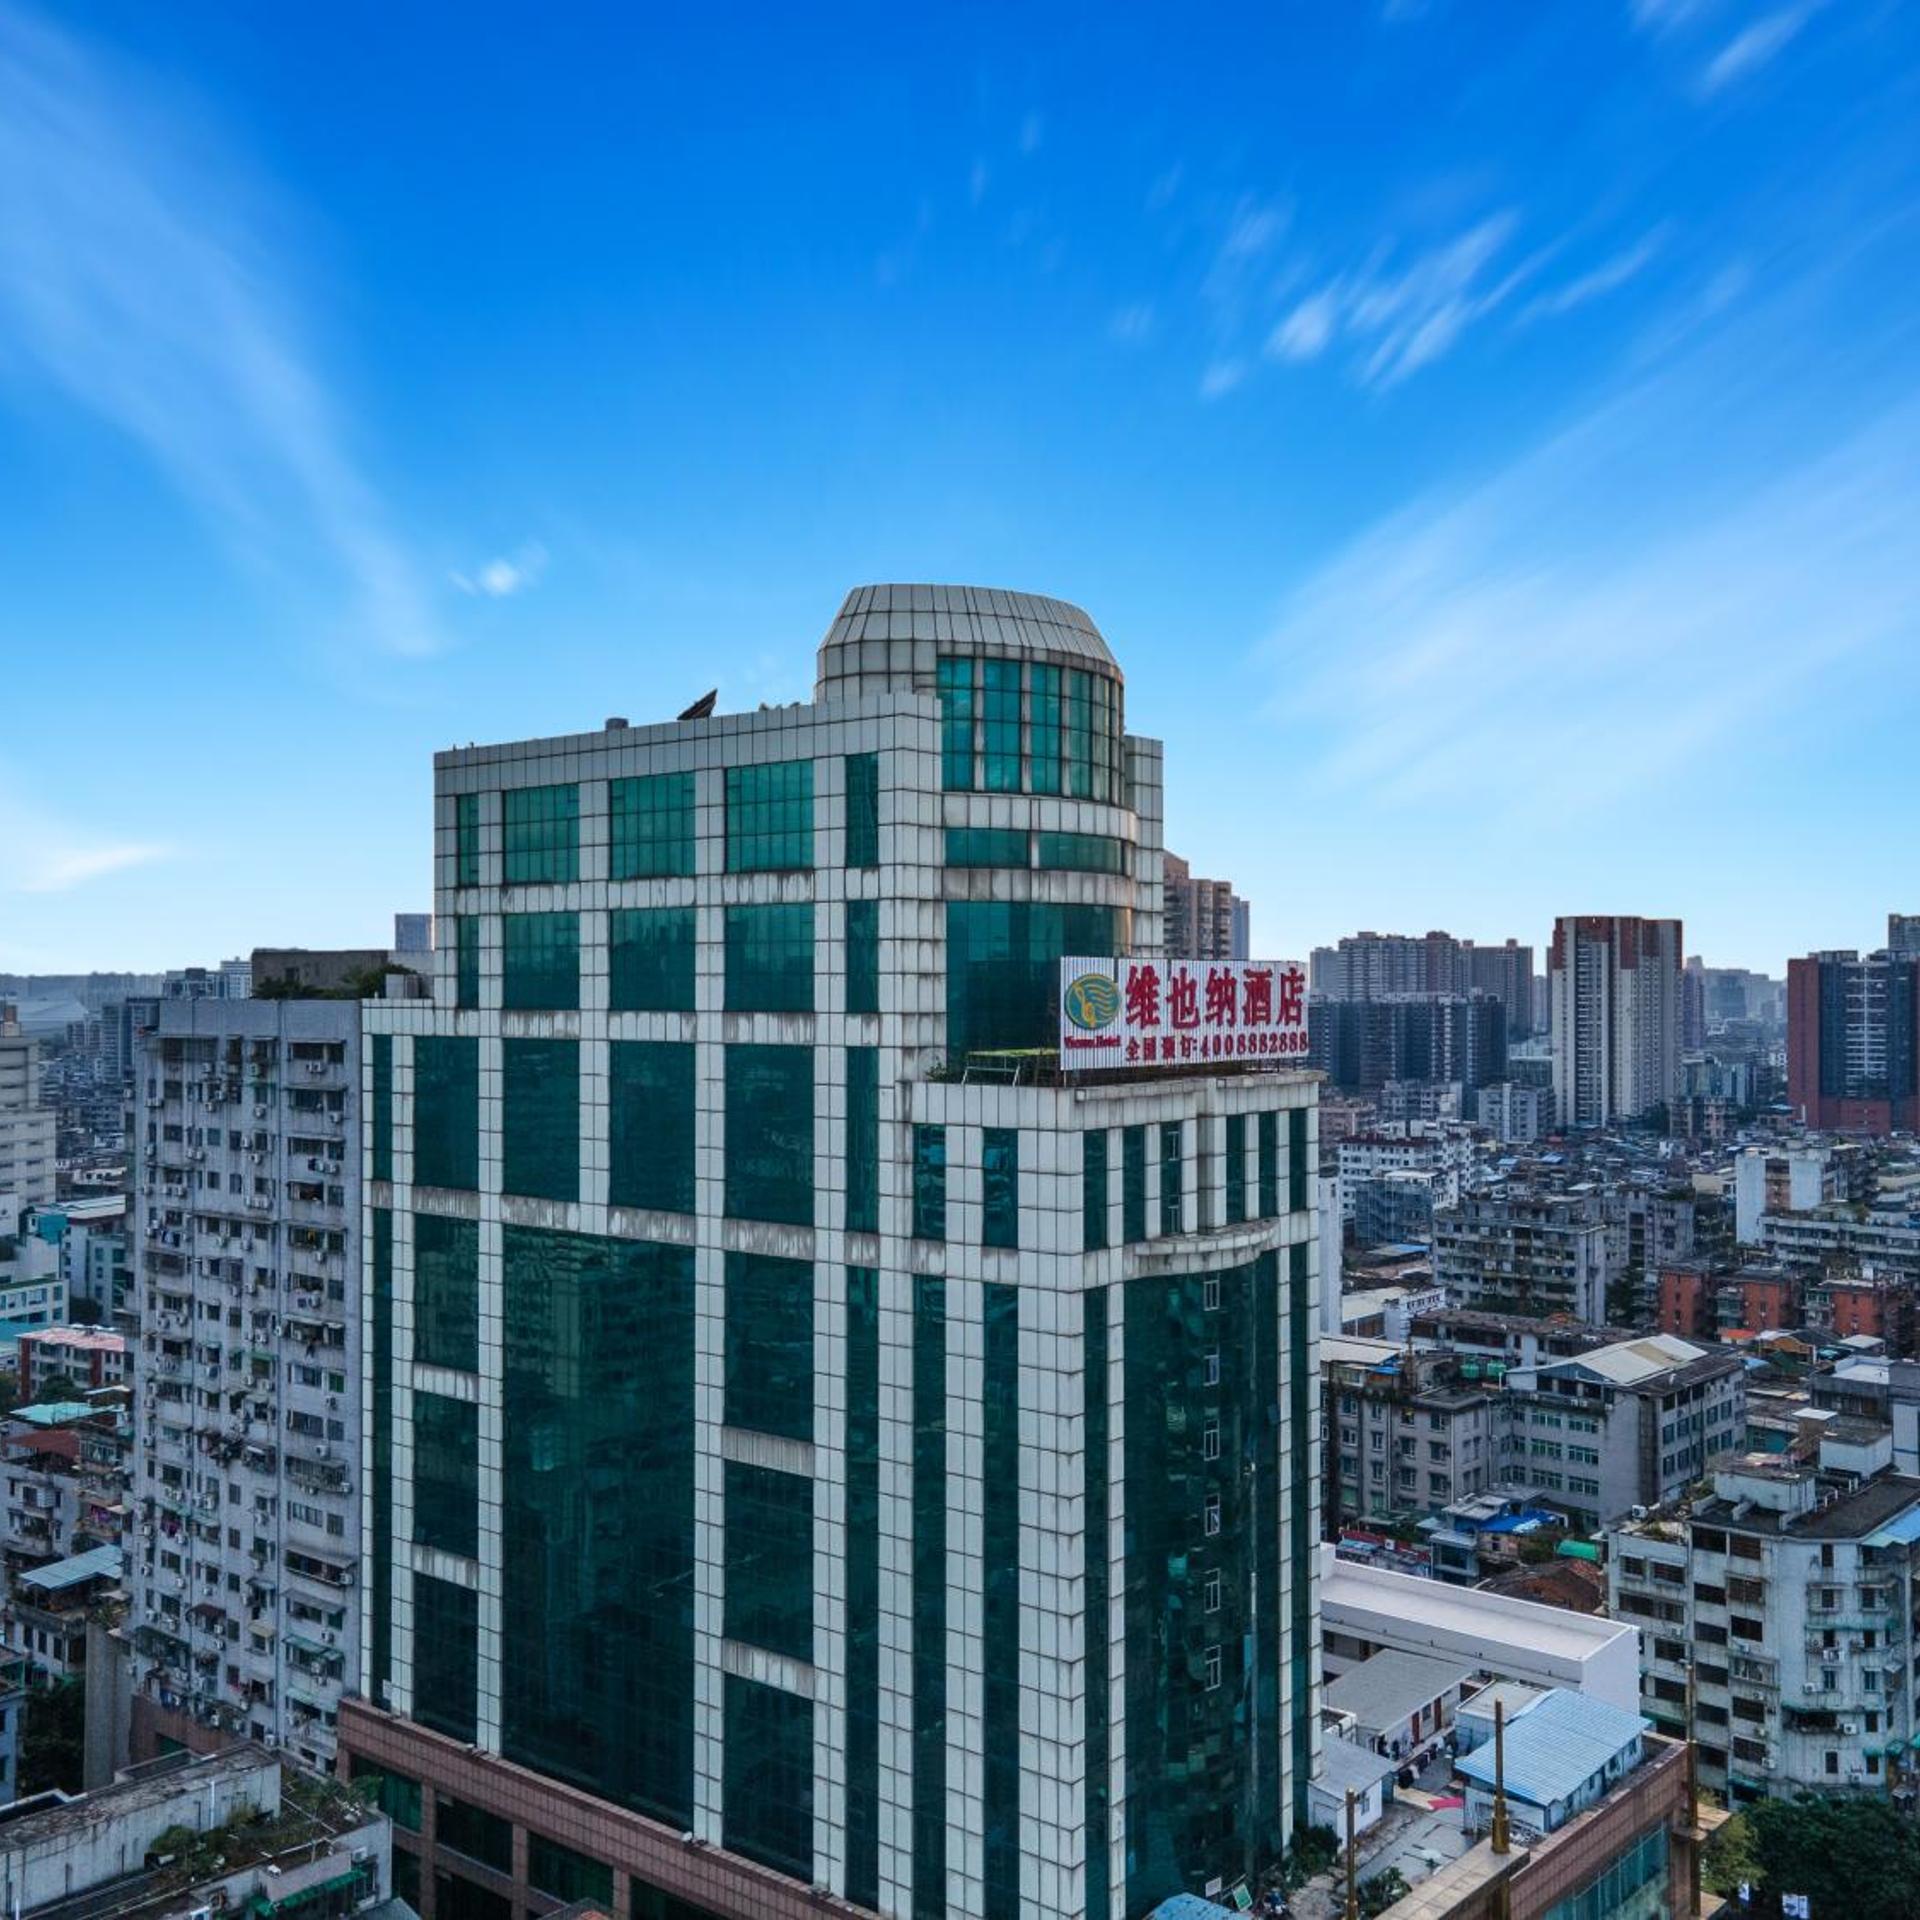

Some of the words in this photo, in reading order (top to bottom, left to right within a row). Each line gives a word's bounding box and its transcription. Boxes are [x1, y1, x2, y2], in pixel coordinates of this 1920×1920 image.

[1125, 965, 1306, 1029] 维也纳酒店
